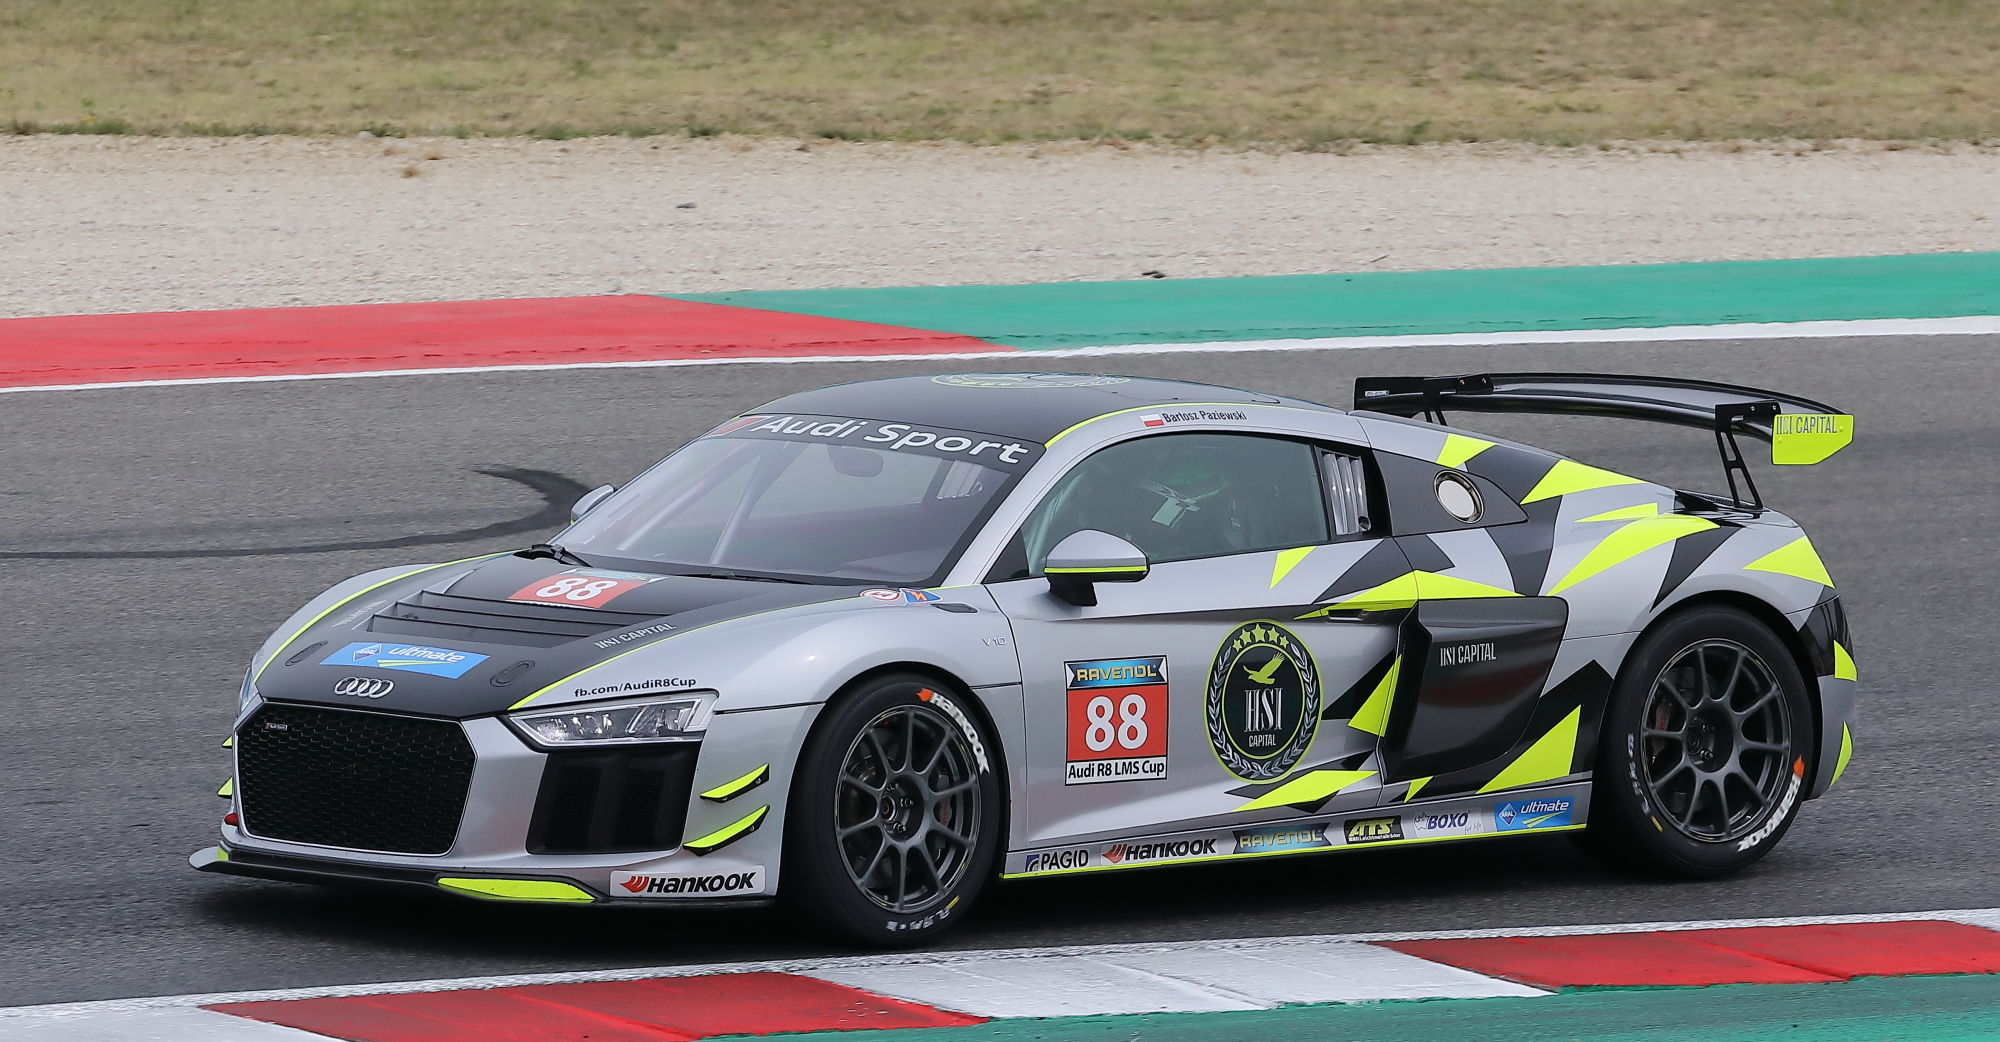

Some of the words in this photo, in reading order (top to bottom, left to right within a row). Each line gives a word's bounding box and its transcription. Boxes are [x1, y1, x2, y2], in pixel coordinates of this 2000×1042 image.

[1162, 411, 1199, 423] Bartosz
[1199, 410, 1247, 421] Paziewski
[1796, 416, 1837, 434] CAPITAL
[749, 416, 869, 439] Audi
[863, 424, 1030, 464] Sport
[535, 577, 619, 601] 88
[619, 623, 677, 642] CAPITAL
[388, 646, 466, 663] ultimate
[1458, 642, 1497, 664] CAPITAL
[1076, 665, 1157, 681] RAVENOL
[574, 678, 697, 698] fb.com/AudiR8Cup
[1244, 687, 1283, 732] HSI
[1085, 693, 1149, 752] 88
[1248, 734, 1276, 747] CAPITAL
[1068, 763, 1095, 779] Audi
[1097, 763, 1112, 777] R8
[1114, 761, 1140, 776] LMS
[1141, 760, 1165, 777] Cup
[1520, 799, 1570, 814] ultimate
[1349, 818, 1395, 837] ATS
[1427, 812, 1469, 830] BOXO
[1239, 830, 1323, 849] RAVENOL
[1041, 849, 1089, 870] PAGID
